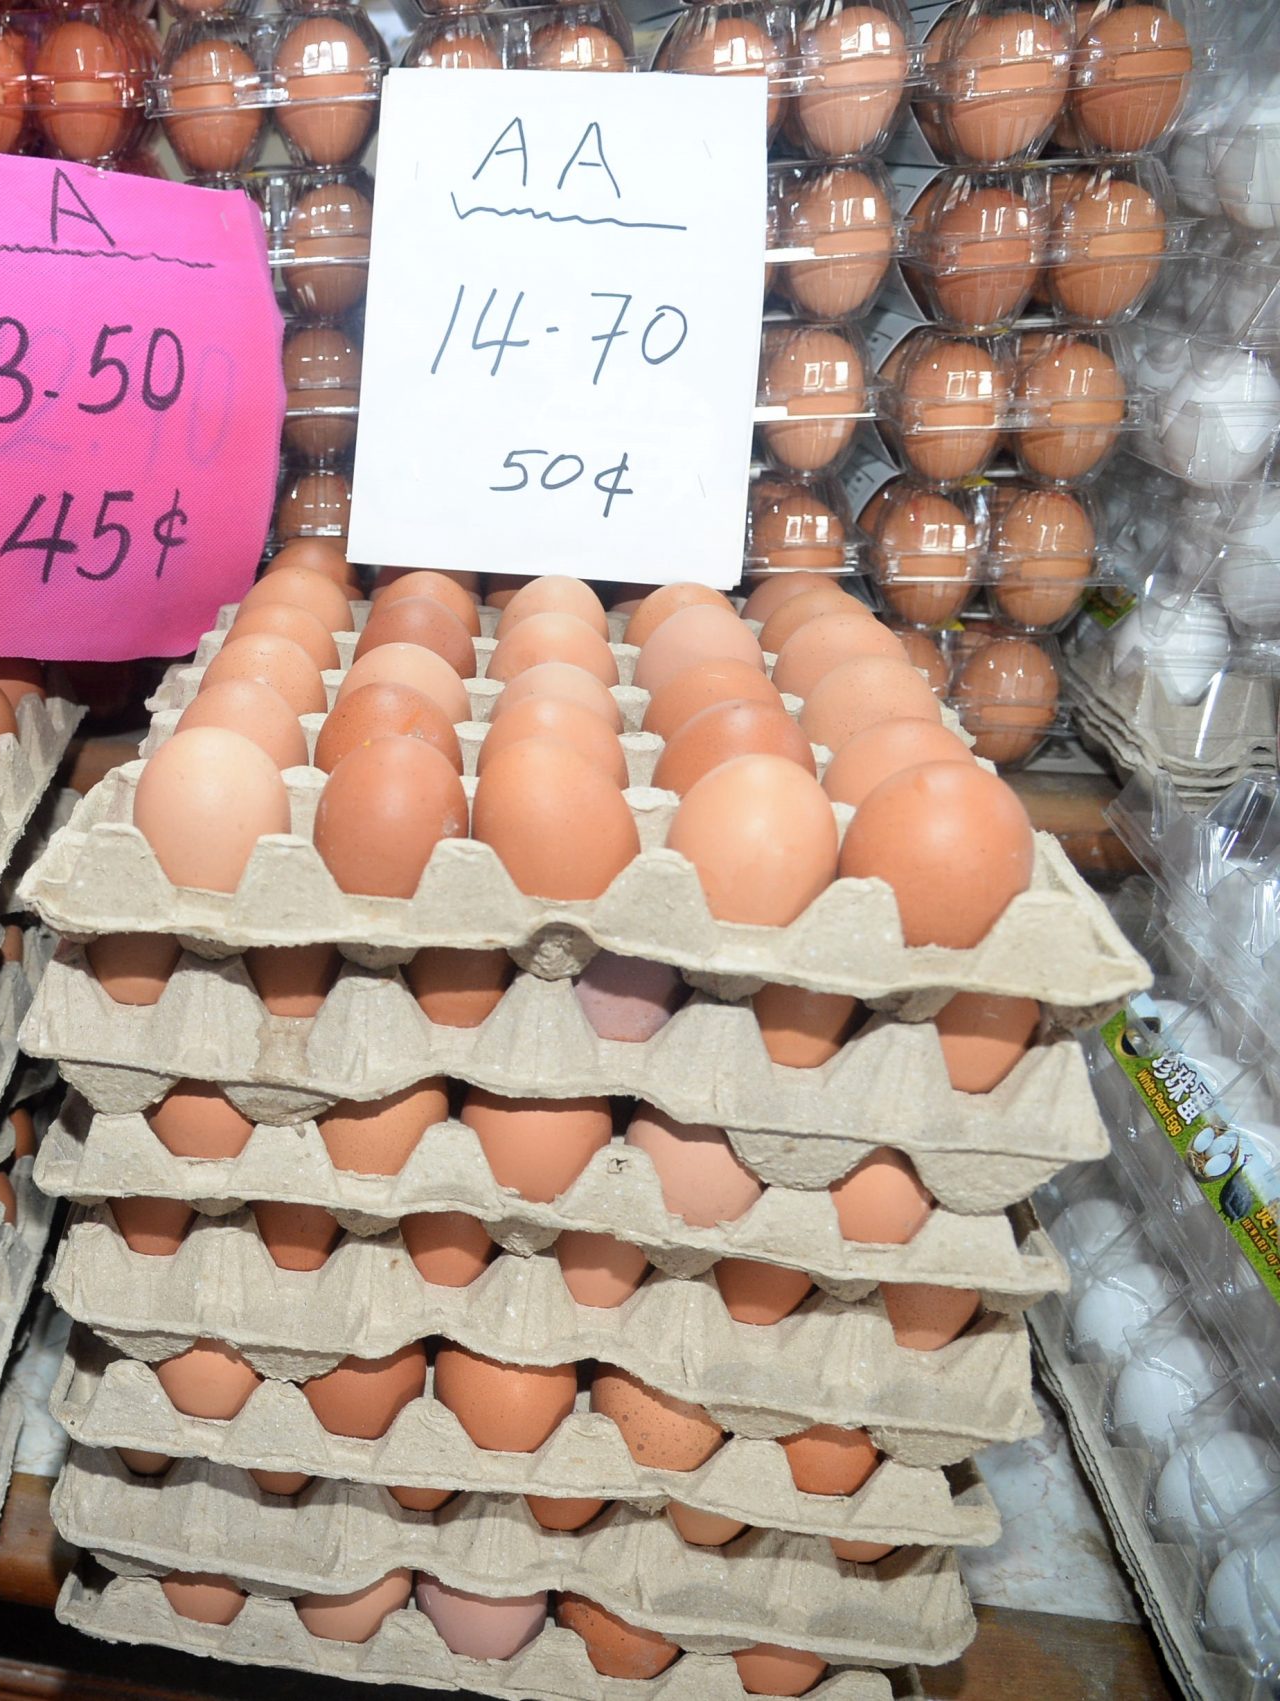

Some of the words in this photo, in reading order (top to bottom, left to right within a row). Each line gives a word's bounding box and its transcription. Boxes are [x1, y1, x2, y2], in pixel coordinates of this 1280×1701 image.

[49, 166, 116, 247] A
[1137, 1069, 1157, 1097] White
[1152, 1092, 1173, 1118] Pearl
[1165, 1111, 1183, 1137] Egg
[1240, 1217, 1271, 1254] BEWARE
